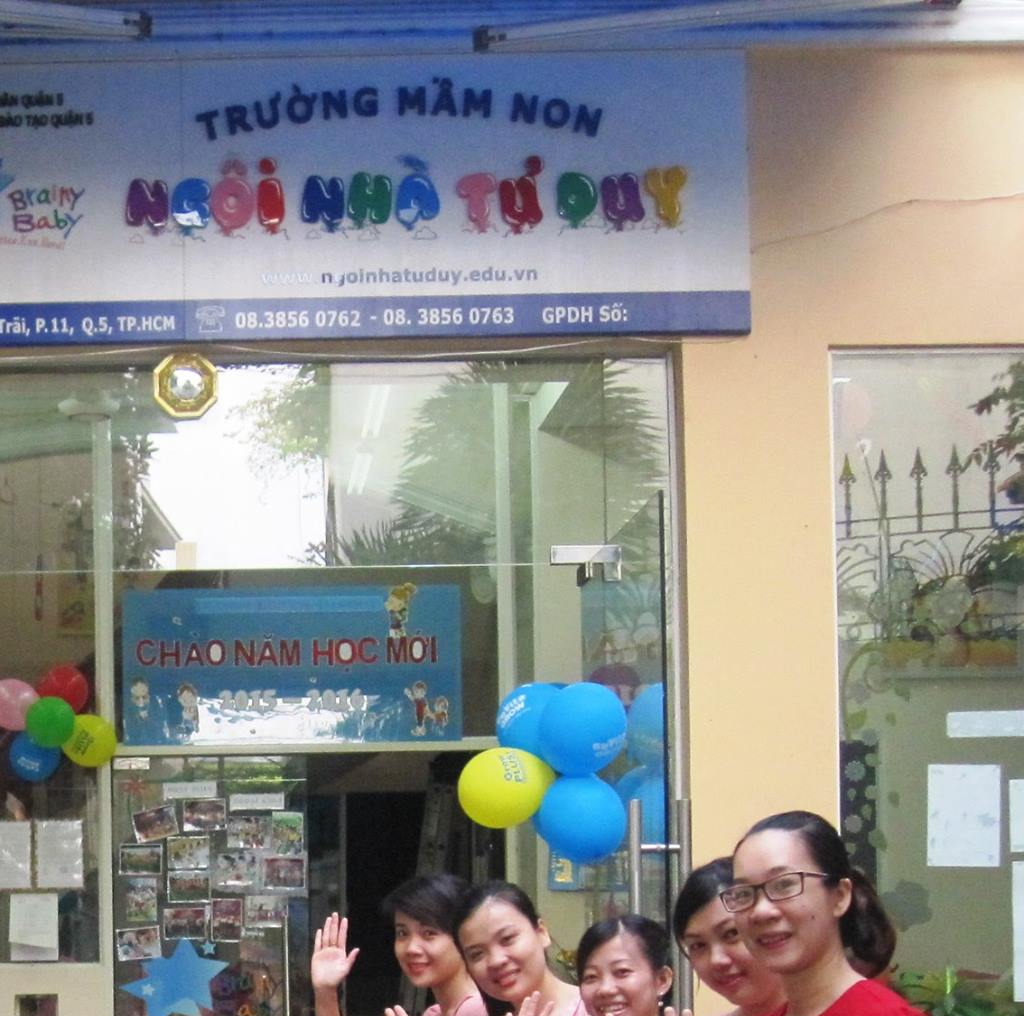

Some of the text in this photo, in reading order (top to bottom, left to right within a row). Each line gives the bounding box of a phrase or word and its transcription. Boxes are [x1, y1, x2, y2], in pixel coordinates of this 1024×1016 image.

[196, 76, 603, 141] TRƯỜNG MẦM NON
[8, 185, 86, 212] Brainy
[300, 154, 440, 234] NHÀ
[556, 164, 688, 232] DUY
[12, 209, 84, 240] Baby
[82, 317, 112, 335] Q.5,
[117, 315, 175, 332] TP.HCM
[235, 311, 309, 328] 08.3856
[315, 311, 361, 327] 0762
[383, 310, 412, 326] 08.
[418, 308, 463, 325] 3856
[469, 307, 514, 324] 0763
[542, 306, 593, 324] GPDH
[599, 302, 628, 322] Số:
[234, 632, 301, 668] NĂM
